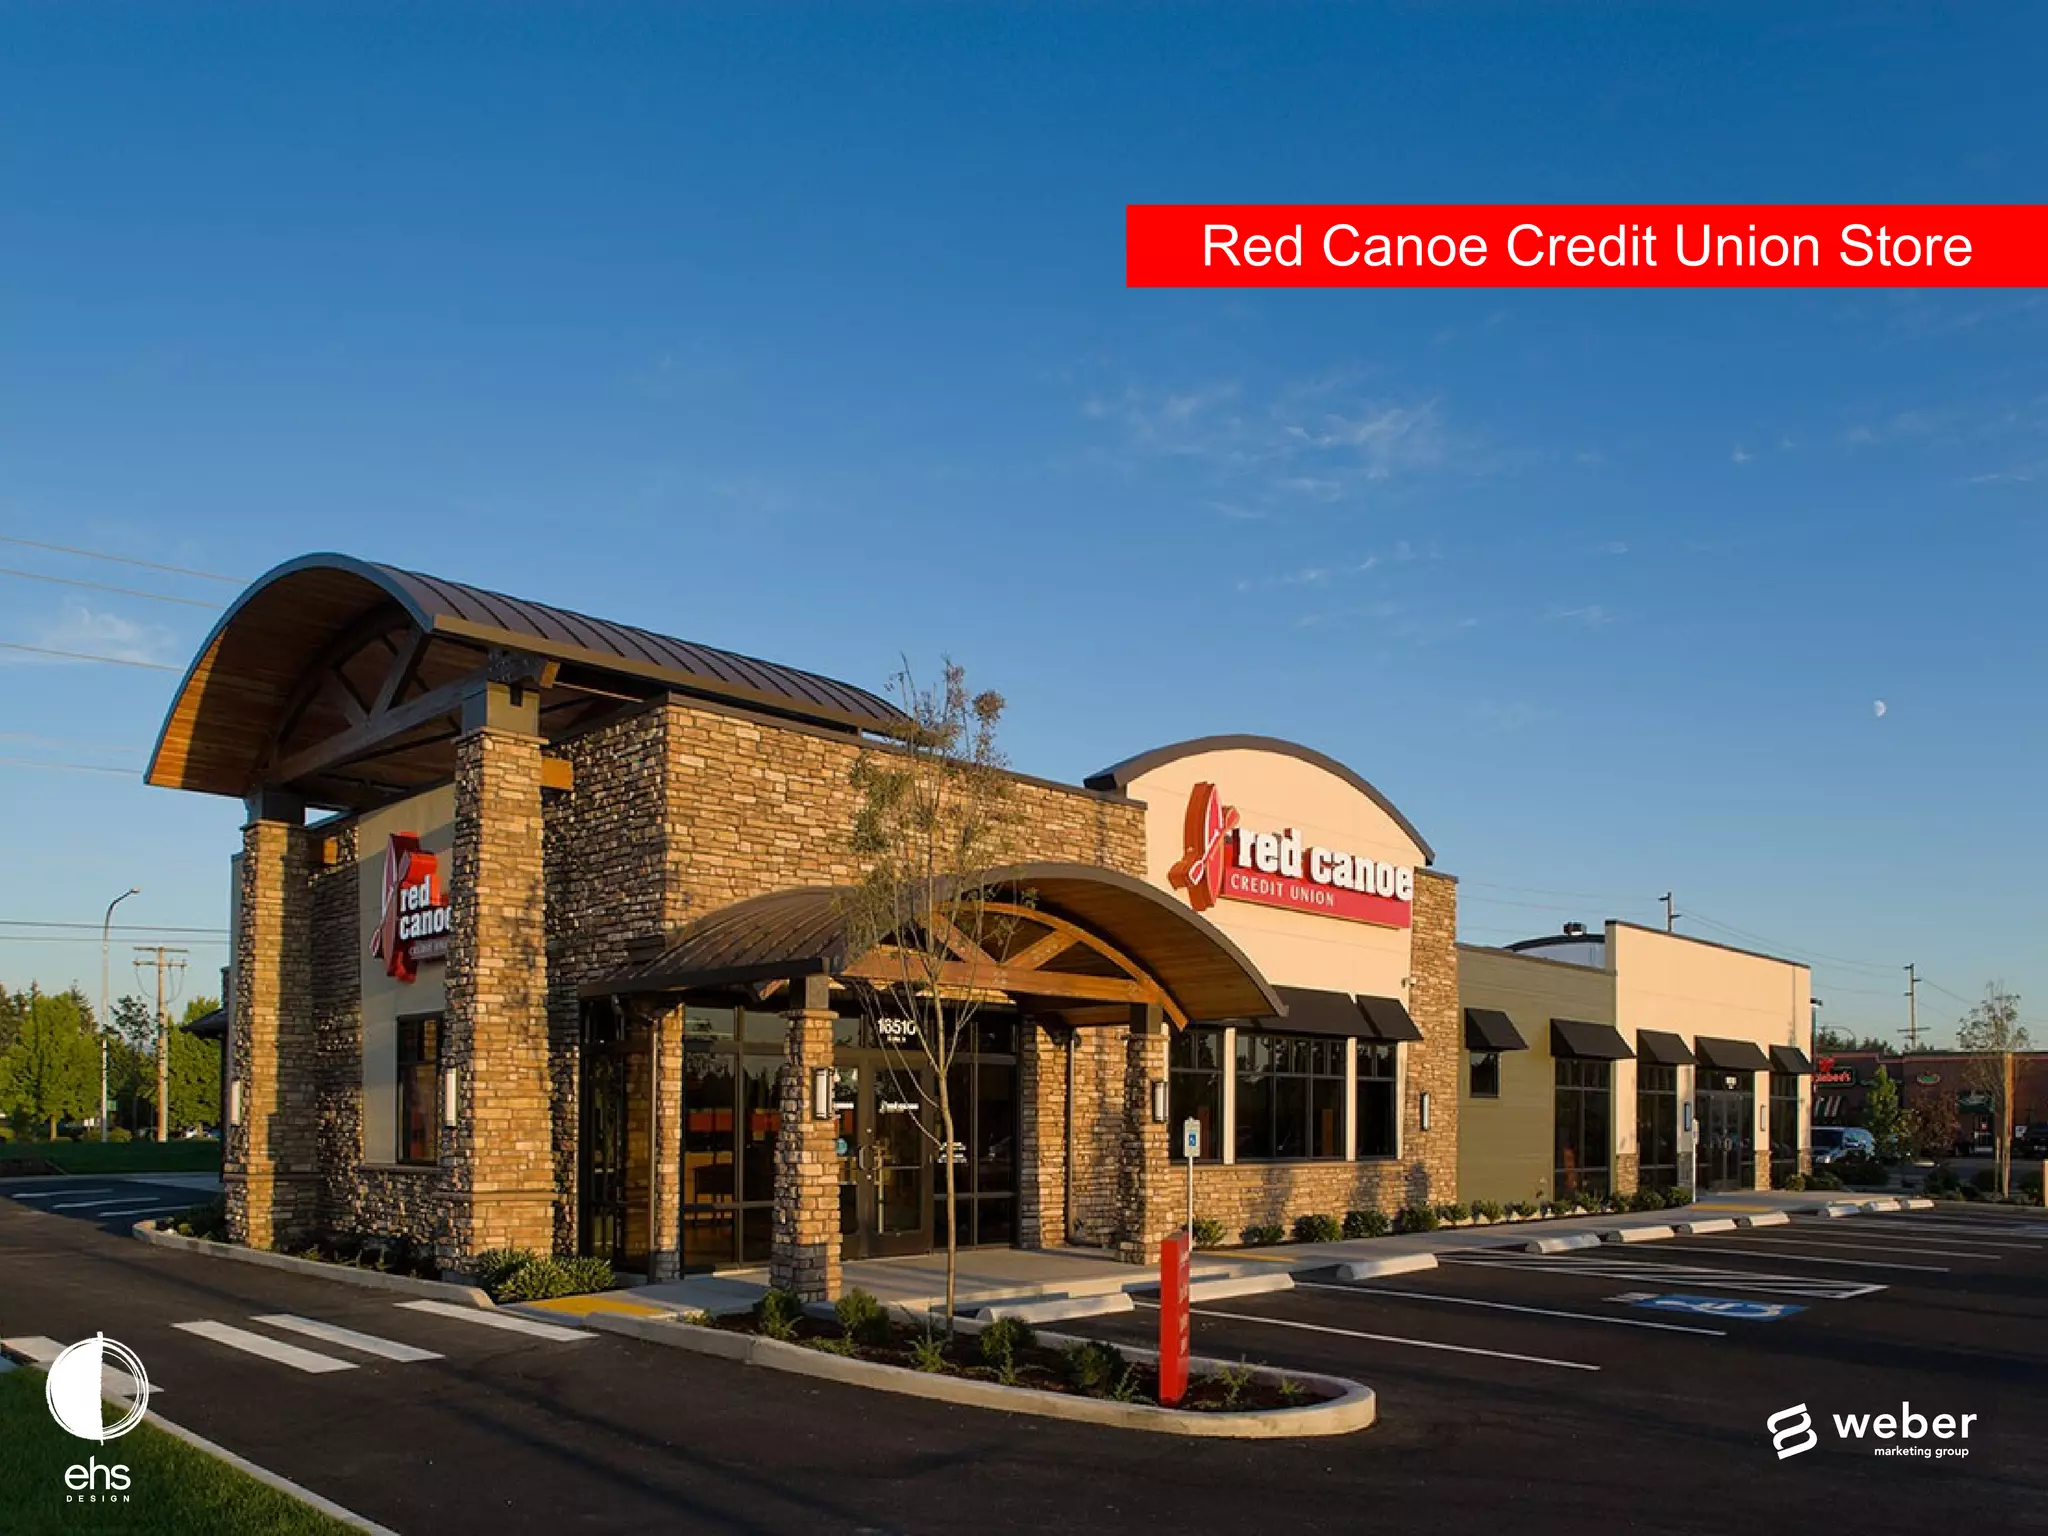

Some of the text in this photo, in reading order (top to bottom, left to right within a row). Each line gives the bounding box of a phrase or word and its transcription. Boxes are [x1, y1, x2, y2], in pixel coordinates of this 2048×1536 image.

[1238, 828, 1413, 901] red canoe
[400, 873, 431, 912] red
[1230, 873, 1334, 907] CREDIT UNION
